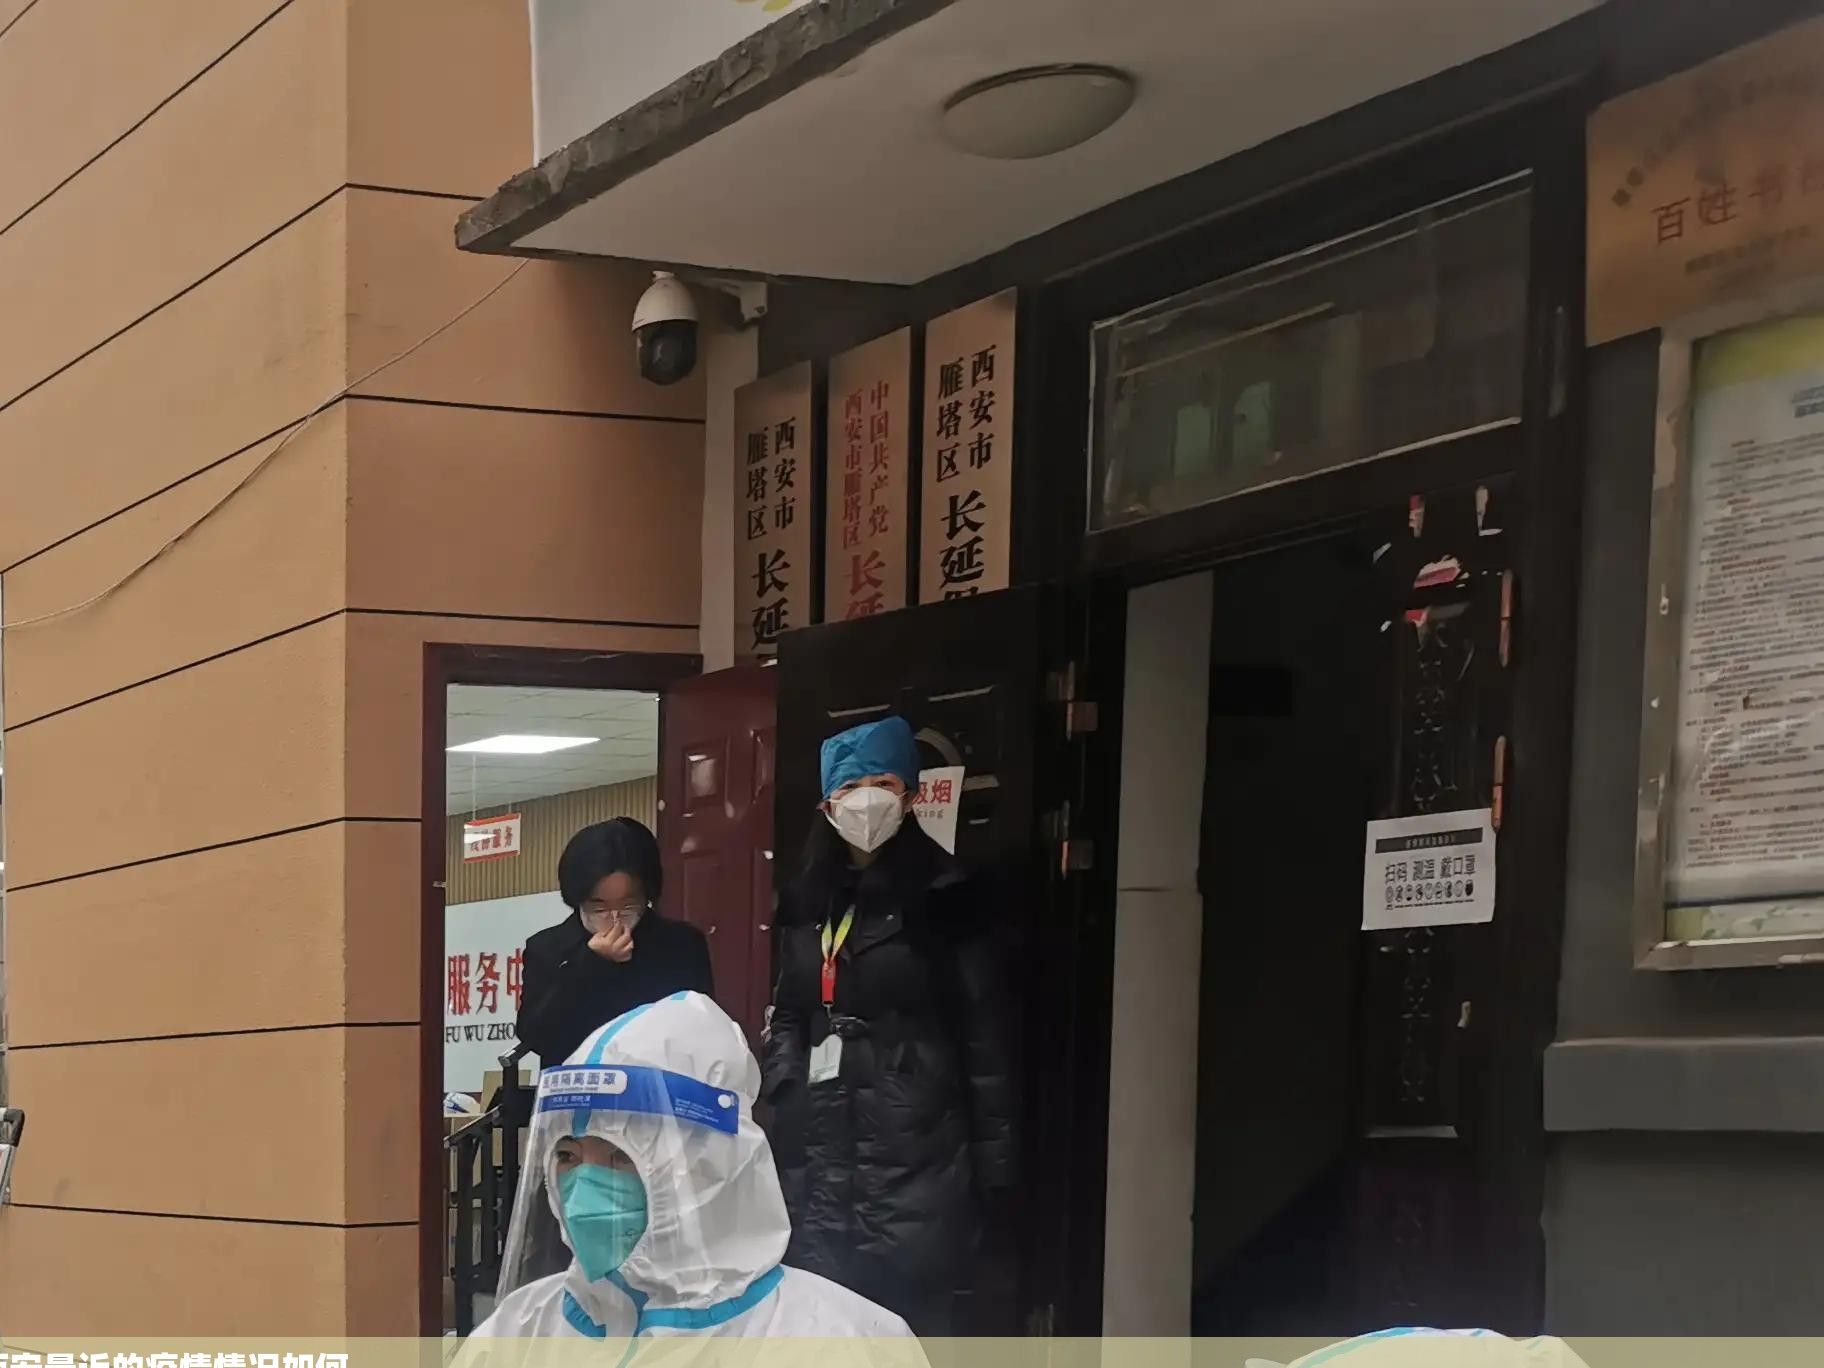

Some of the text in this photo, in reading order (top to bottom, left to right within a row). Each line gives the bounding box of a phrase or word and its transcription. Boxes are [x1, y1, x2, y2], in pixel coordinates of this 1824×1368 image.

[868, 380, 890, 538] 中国共产党
[936, 356, 964, 483] 雁塔区
[968, 344, 997, 470] 西安市
[746, 426, 769, 541] 雁塔区
[773, 416, 797, 530] 西安市
[842, 388, 864, 551] 西安市雁塔区
[940, 490, 987, 600] 长延
[750, 549, 792, 667] 长延
[445, 1026, 461, 1043] FU
[464, 1024, 485, 1042] WU
